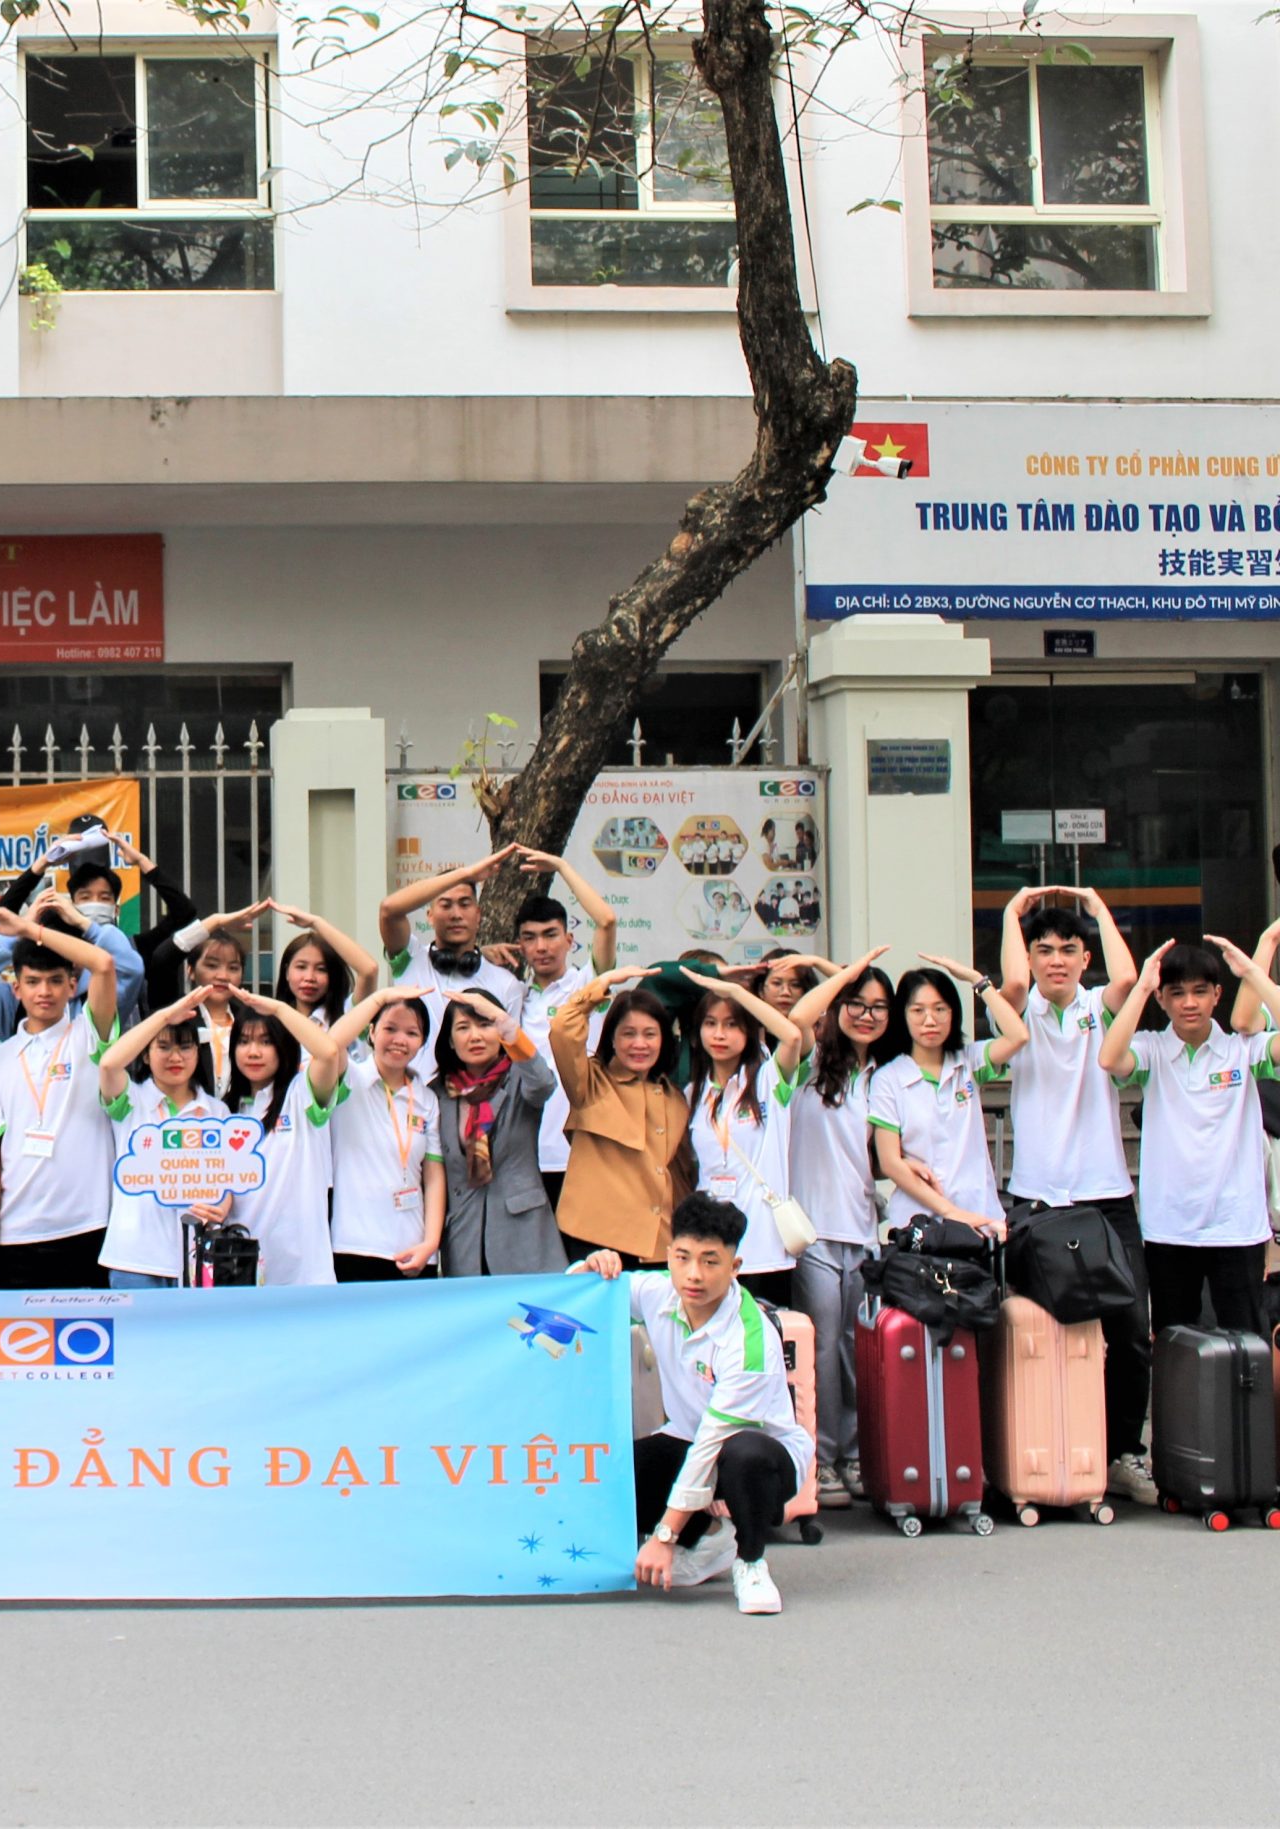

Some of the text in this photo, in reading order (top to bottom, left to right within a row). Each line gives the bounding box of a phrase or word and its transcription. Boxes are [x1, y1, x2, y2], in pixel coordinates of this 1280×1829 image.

[1026, 451, 1080, 476] CÔNG
[1086, 456, 1109, 476] TY
[1115, 449, 1143, 477] CỔ
[1149, 449, 1200, 476] PHẦN
[1206, 456, 1260, 477] CUNG
[915, 502, 1008, 531] TRUNG
[1017, 499, 1075, 531] TÂM
[1085, 499, 1140, 532] ĐÀO
[1149, 503, 1205, 538] TẠO
[1209, 499, 1246, 532] VÀ
[69, 581, 139, 626] LÀM
[835, 597, 860, 613] ĐỊA
[862, 593, 891, 609] CHỈ:
[893, 594, 911, 609] LÔ
[915, 596, 952, 611] 2BX3,
[955, 593, 1011, 610] ĐƯỜNG
[1014, 591, 1072, 610] NGUYỄN
[1075, 595, 1097, 610] CƠ
[1099, 596, 1149, 613] THẠCH,
[1152, 597, 1182, 610] KHU
[1184, 594, 1207, 610] ĐÔ
[1209, 597, 1231, 613] THỊ
[1235, 594, 1256, 610] MỸ
[56, 647, 95, 659] Hotline:
[668, 790, 695, 806] VIỆT
[123, 1174, 154, 1187] DỊCH
[160, 1174, 177, 1187] VỤ
[182, 1174, 201, 1184] DU
[205, 1174, 234, 1186] LỊCH
[24, 1296, 45, 1305] for
[50, 1296, 94, 1304] better
[13, 1428, 232, 1489] ĐẲNG
[266, 1446, 399, 1497] ĐẠI
[431, 1434, 610, 1495] VIỆT
